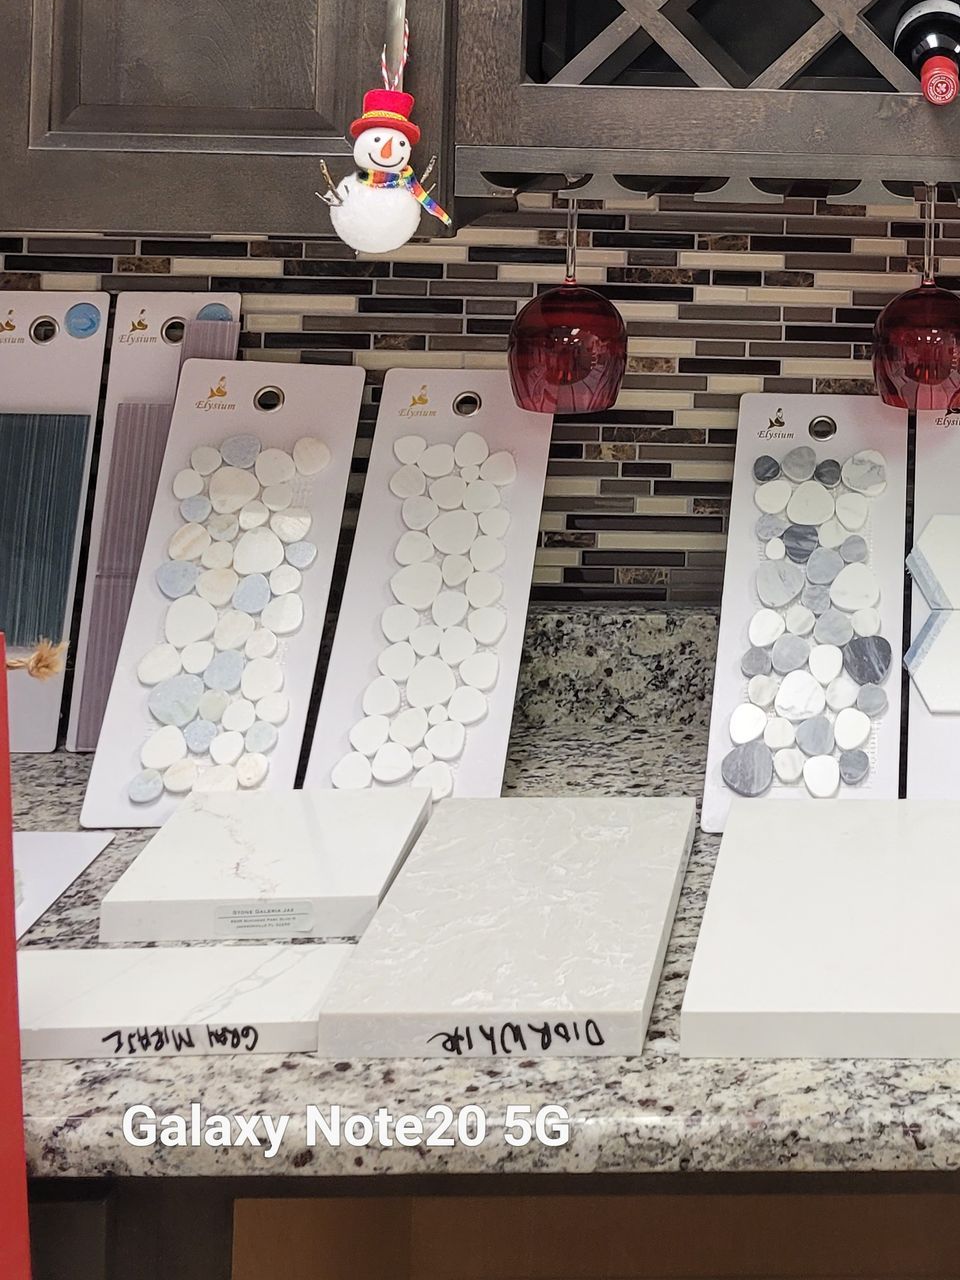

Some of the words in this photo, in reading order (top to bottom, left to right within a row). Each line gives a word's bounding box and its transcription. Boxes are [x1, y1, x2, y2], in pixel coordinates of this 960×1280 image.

[118, 333, 158, 346] Elysium
[194, 399, 237, 412] Elysium
[398, 407, 437, 419] Elysium
[756, 429, 795, 442] Elysium
[206, 1023, 260, 1052] GRAY
